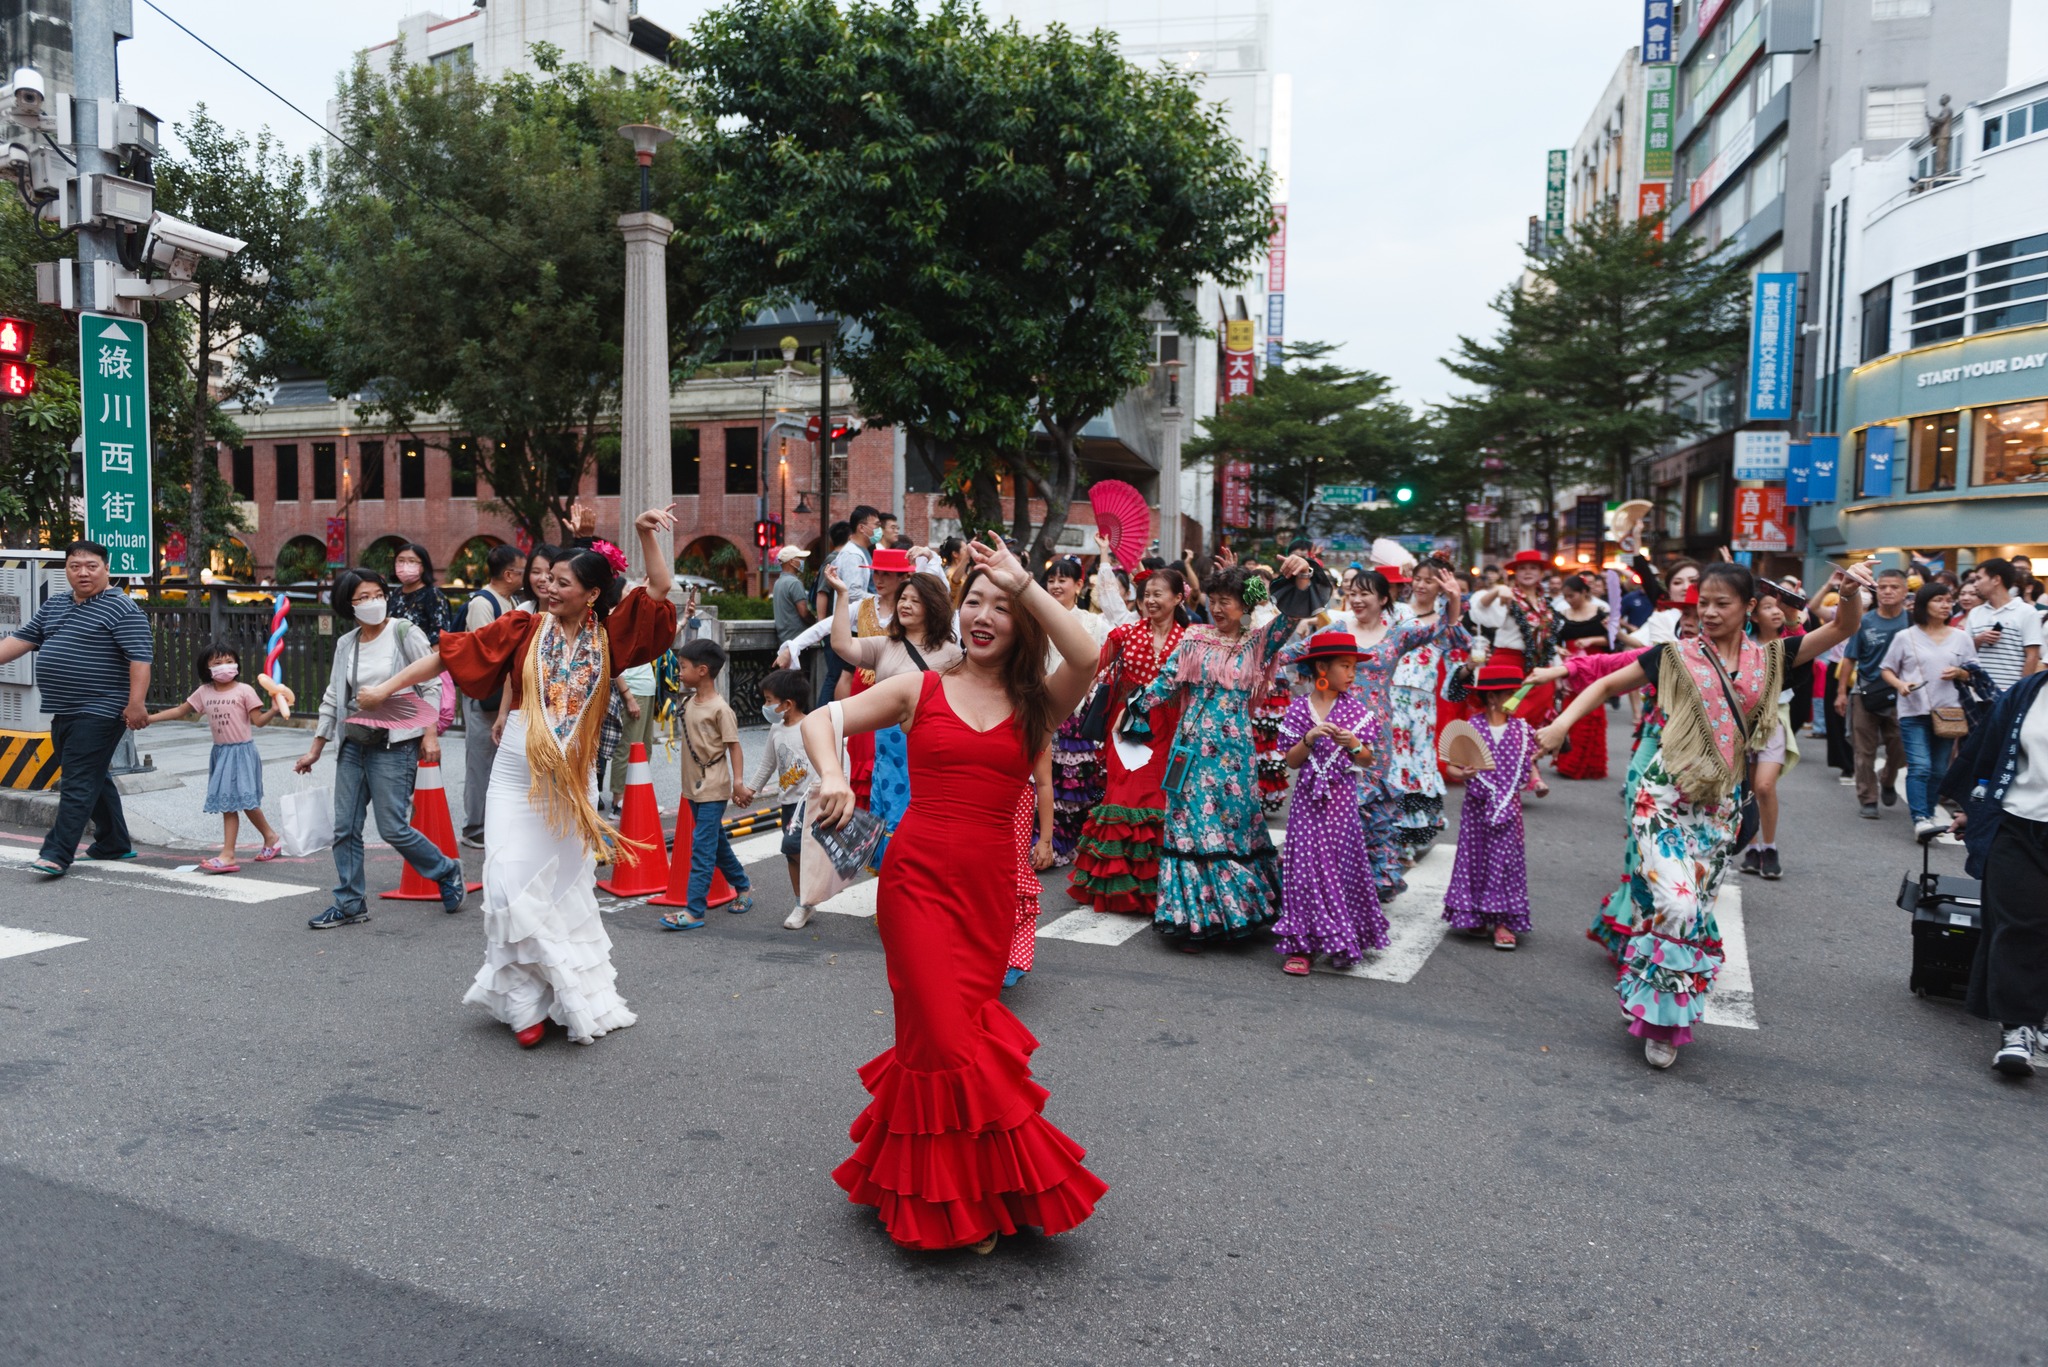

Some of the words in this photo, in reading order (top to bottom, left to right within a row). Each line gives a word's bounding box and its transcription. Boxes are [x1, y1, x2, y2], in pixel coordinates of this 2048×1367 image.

[1650, 92, 1669, 149] 語言樹
[1917, 368, 1961, 388] START
[1961, 359, 2007, 378] YOUR
[2010, 352, 2048, 371] DAY
[98, 344, 135, 523] 綠川西街
[121, 552, 138, 571] St.
